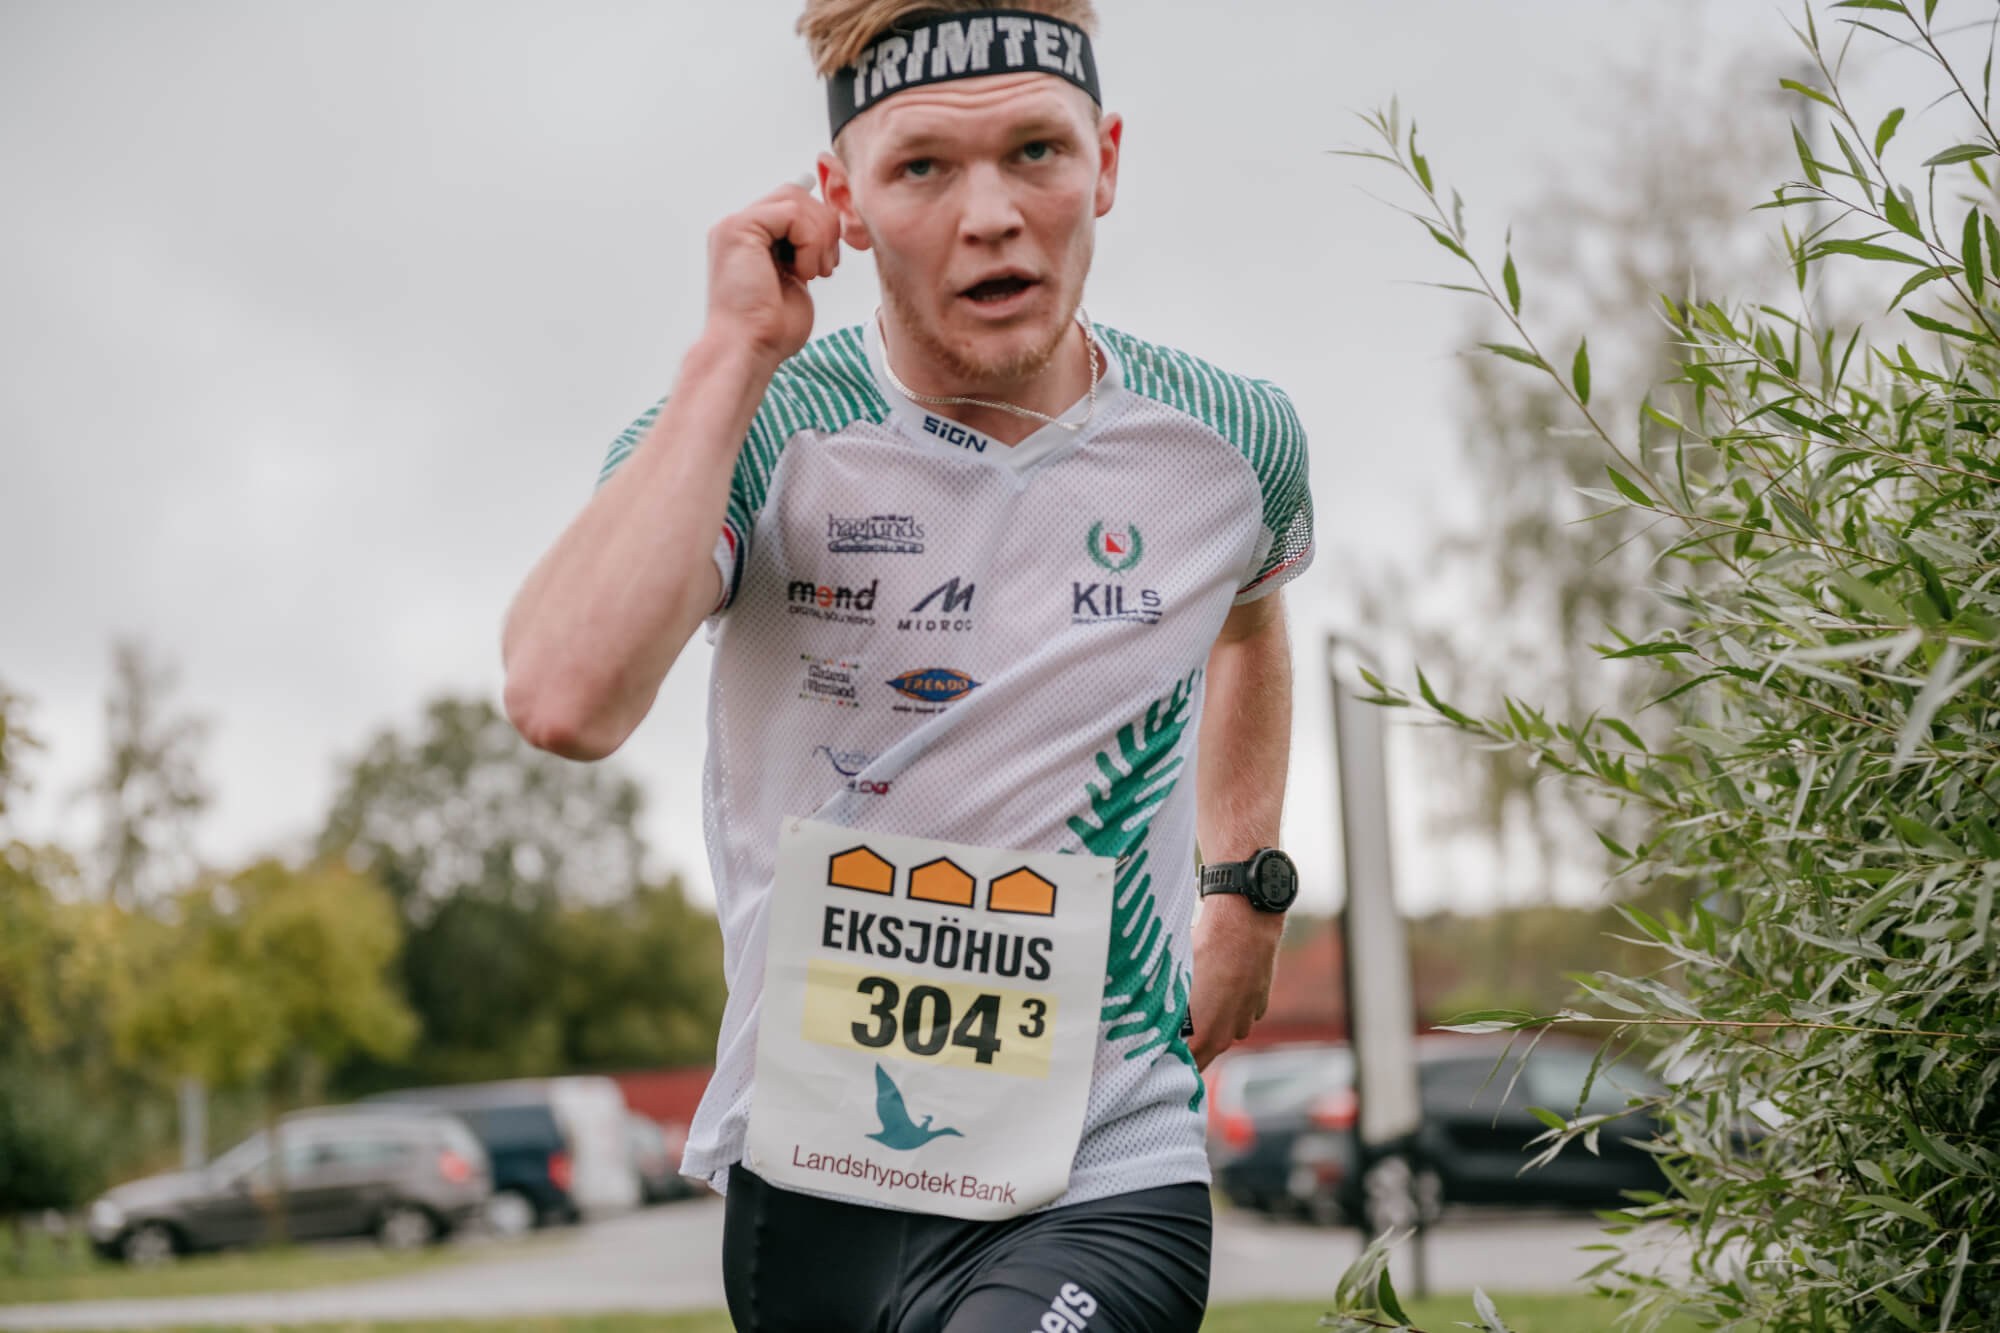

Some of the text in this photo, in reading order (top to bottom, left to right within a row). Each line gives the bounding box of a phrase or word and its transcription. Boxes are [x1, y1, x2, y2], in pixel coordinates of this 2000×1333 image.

[852, 16, 1086, 108] TRIMTEX
[897, 619, 973, 631] MIDROC
[822, 906, 1053, 981] EKSJÖHUS
[851, 977, 1047, 1064] 304 3
[792, 1145, 1018, 1205] Landshypotek Bank
